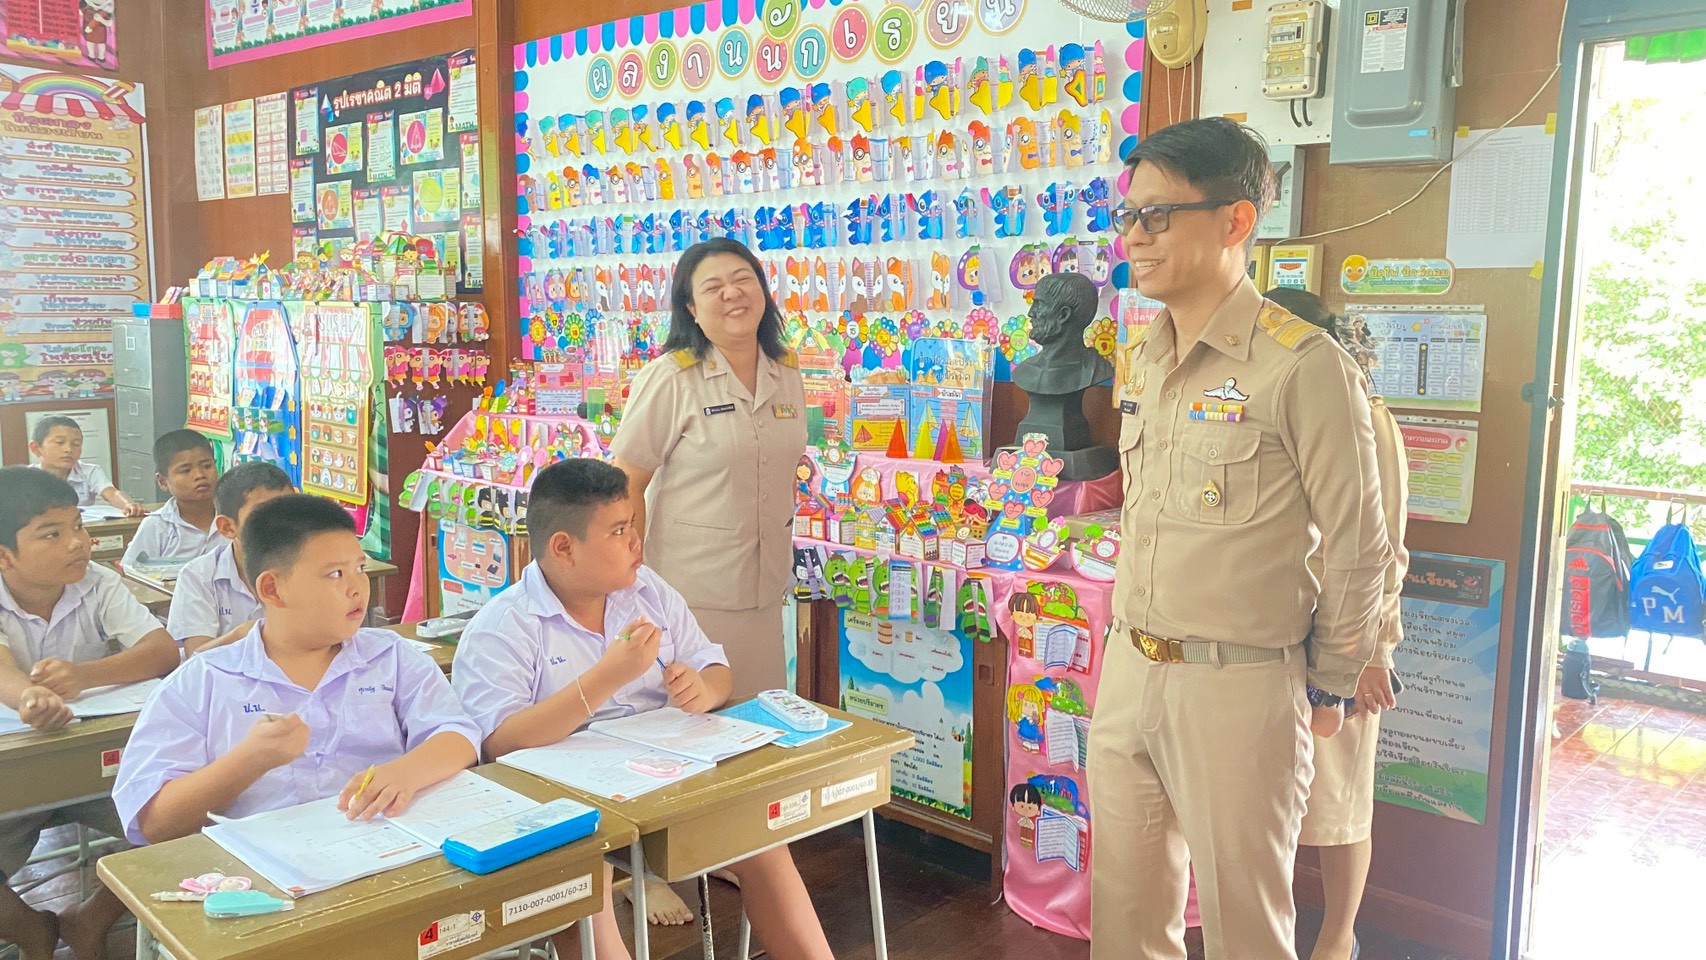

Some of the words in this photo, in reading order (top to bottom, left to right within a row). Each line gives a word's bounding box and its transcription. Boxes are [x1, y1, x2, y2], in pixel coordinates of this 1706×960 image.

[592, 0, 1018, 93] ผลงานนักเรยน
[333, 79, 392, 118] รูปเรขาคณิต
[394, 80, 402, 97] 2
[404, 71, 422, 96] มิติ
[455, 120, 474, 130] MATH
[1369, 265, 1399, 279] ปิดไฟ
[1641, 597, 1656, 617] P
[1661, 605, 1685, 624] M
[847, 616, 872, 628] เครื่องตวง
[242, 702, 266, 713] ป.น.
[508, 881, 589, 917] 7110-007-0001/60-23
[424, 926, 434, 941] 4
